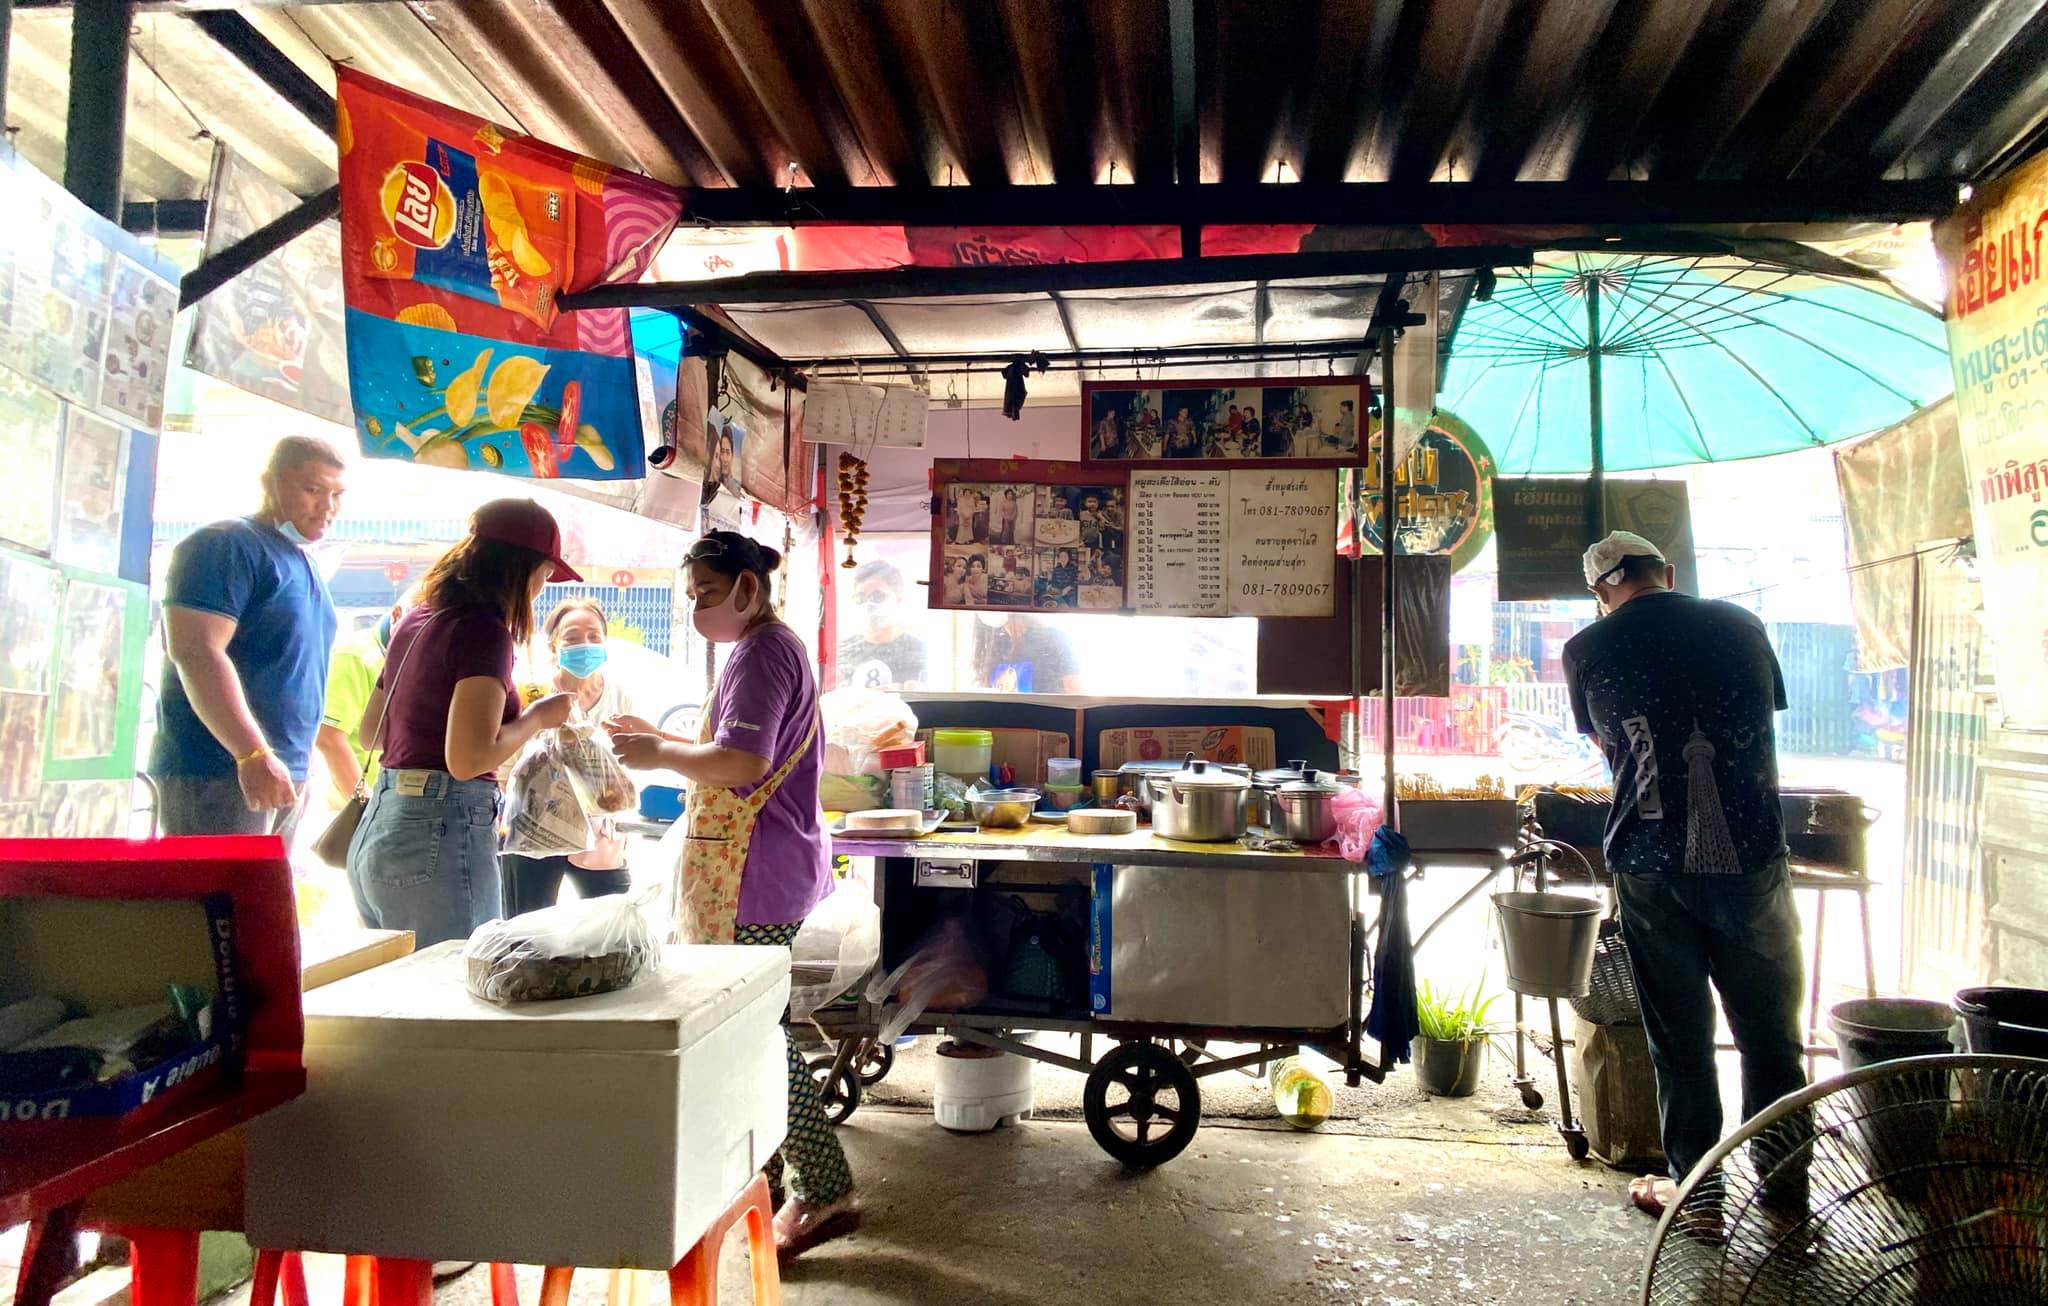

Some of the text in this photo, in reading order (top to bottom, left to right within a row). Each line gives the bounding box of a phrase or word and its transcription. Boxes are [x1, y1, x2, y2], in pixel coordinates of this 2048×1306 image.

[1259, 505, 1331, 516] 081-7809067
[1242, 583, 1331, 596] 081-7809067
[140, 1075, 161, 1105] A
